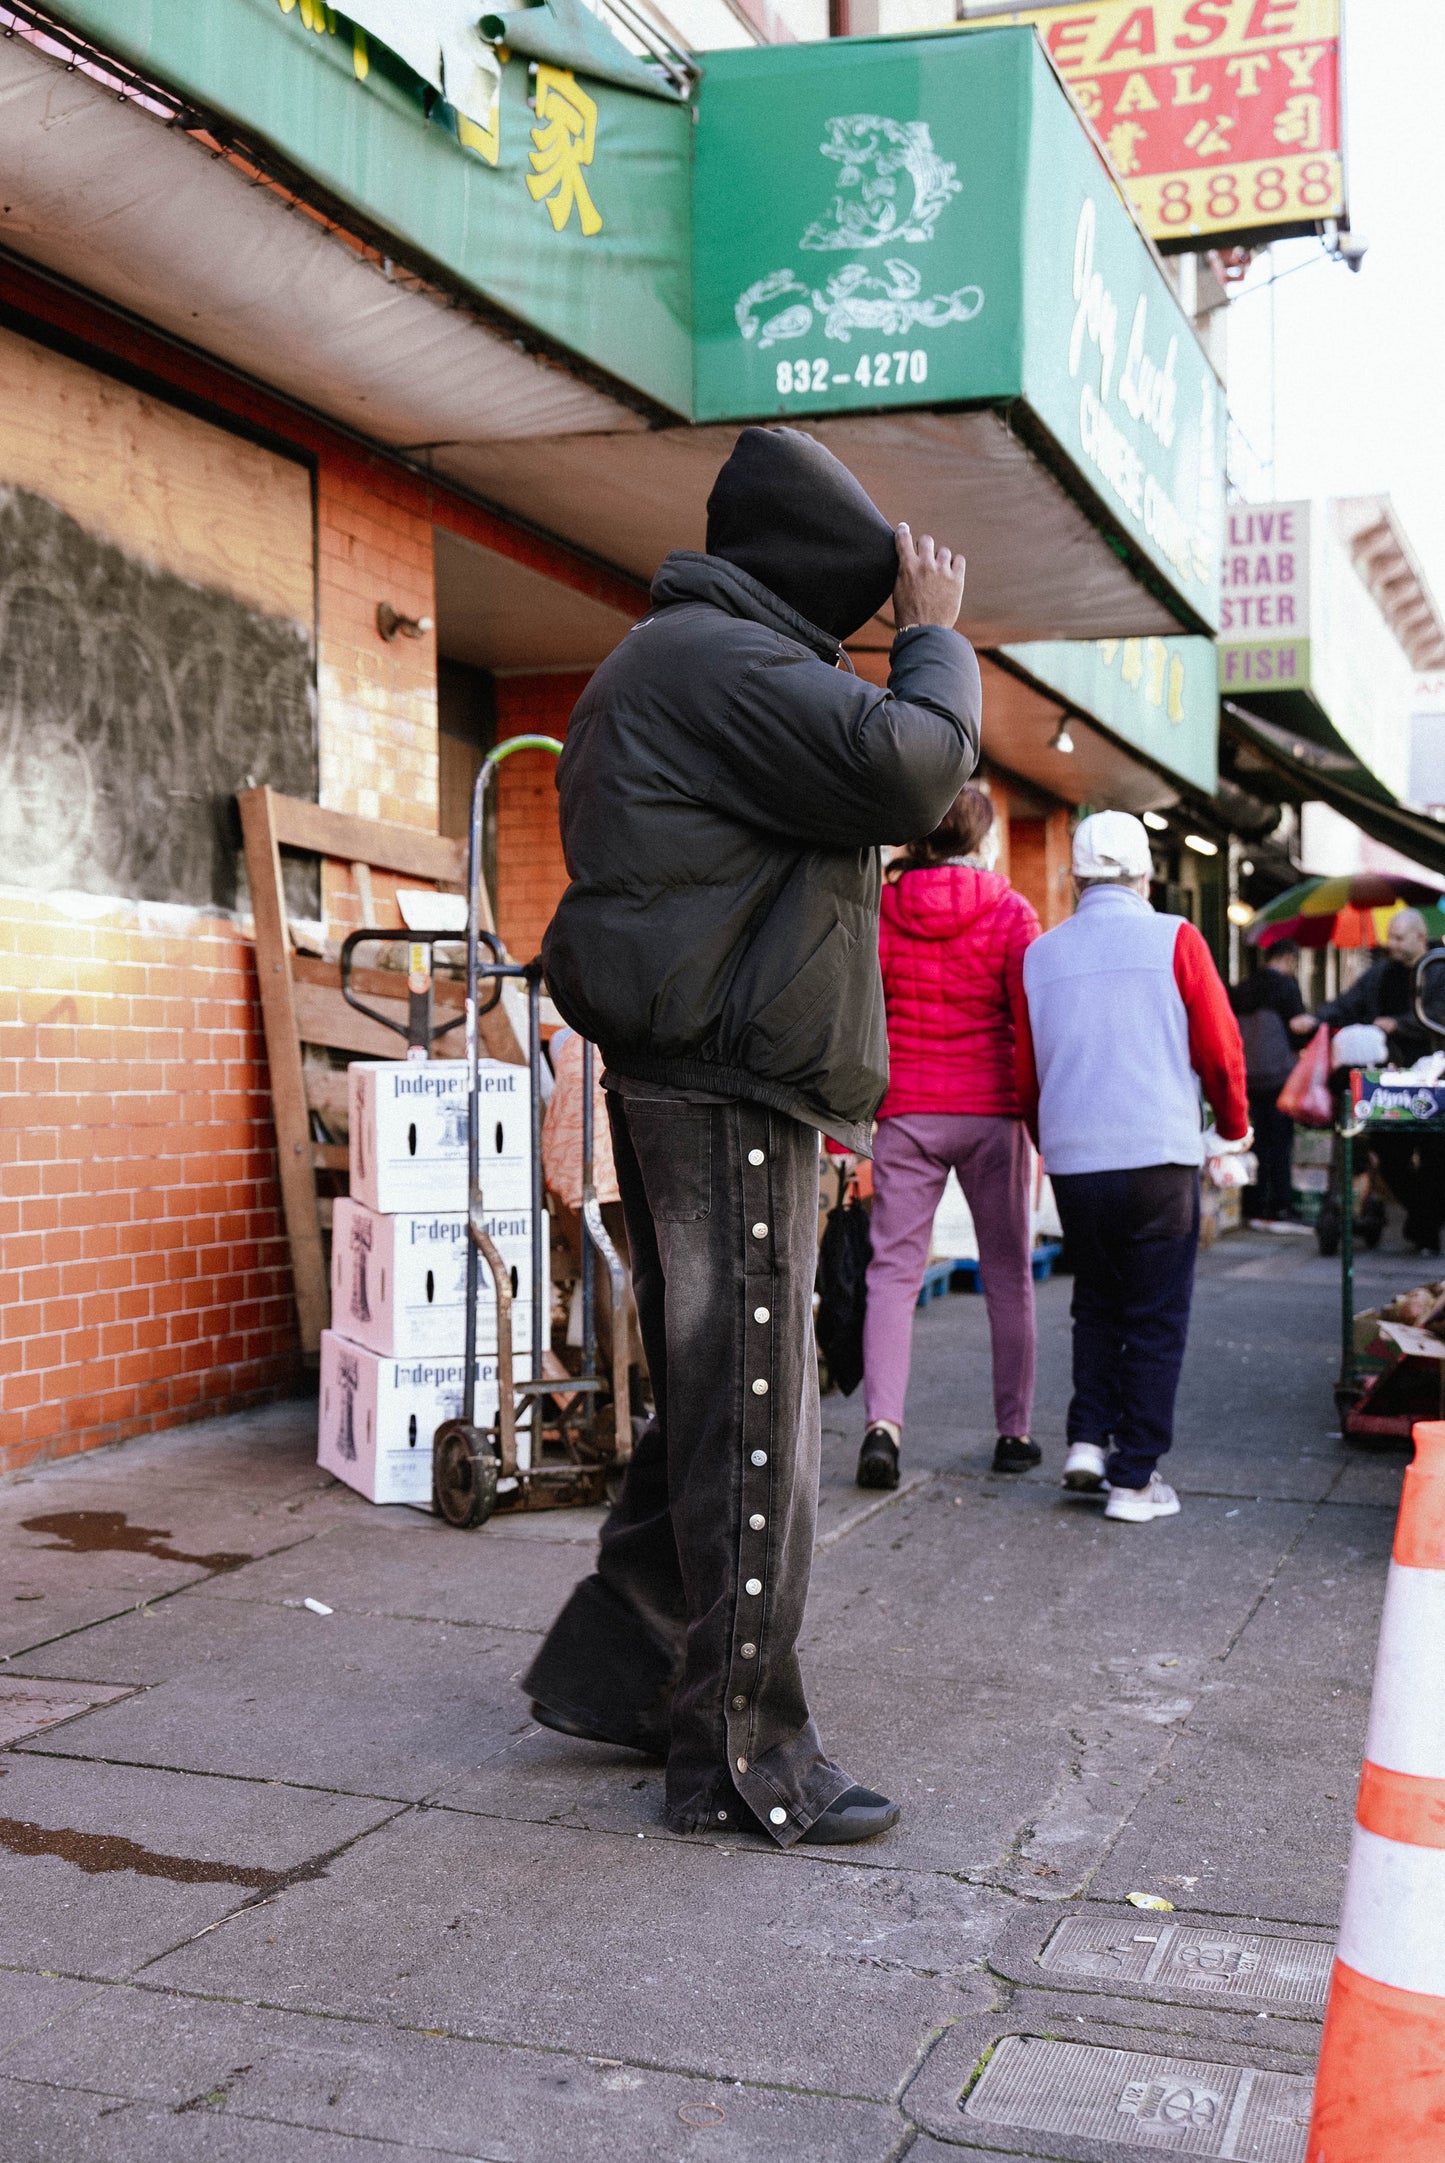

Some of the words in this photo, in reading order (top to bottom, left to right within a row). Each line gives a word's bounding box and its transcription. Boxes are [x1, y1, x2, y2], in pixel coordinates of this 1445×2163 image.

[1047, 0, 1297, 68] EASE
[775, 349, 928, 394] 832-4270
[1229, 511, 1295, 546] LIVE
[1225, 648, 1296, 681] FISH
[394, 1073, 517, 1098] Indepeent
[411, 1217, 527, 1245] Idepdent
